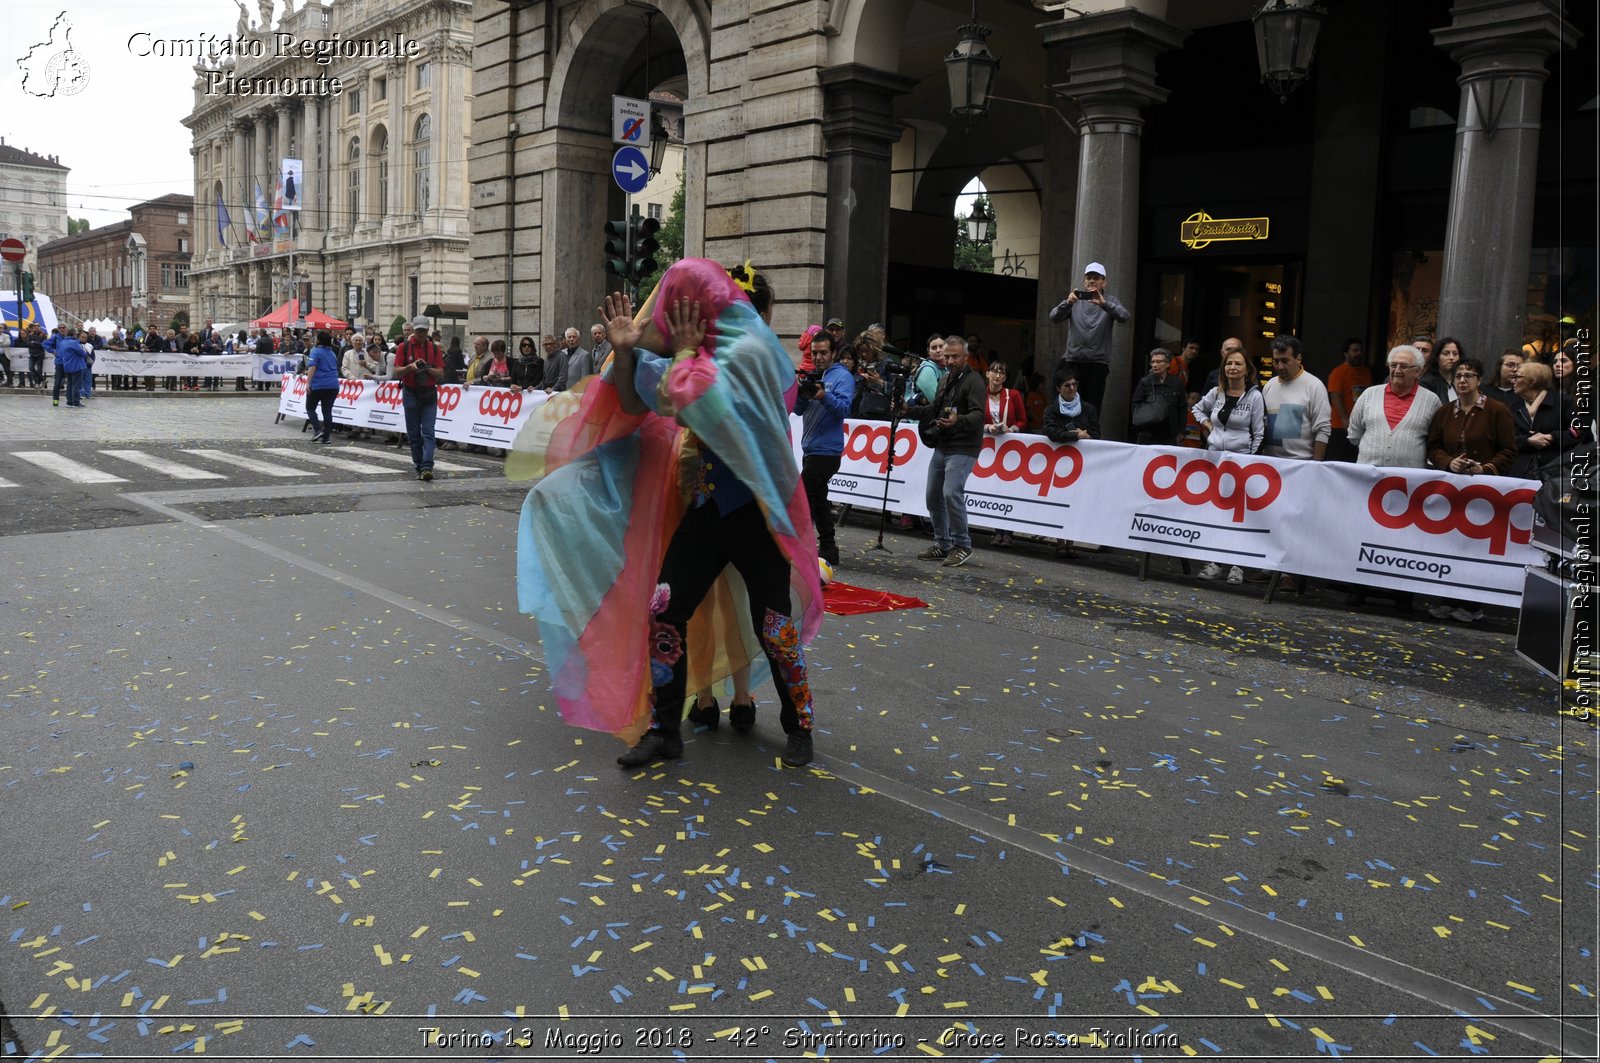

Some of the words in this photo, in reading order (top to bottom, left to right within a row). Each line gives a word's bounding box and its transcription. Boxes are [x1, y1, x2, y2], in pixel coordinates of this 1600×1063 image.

[620, 108, 645, 117] pedonale
[262, 360, 299, 375] Cuk
[479, 390, 523, 424] coop
[471, 425, 493, 437] Novacoop
[828, 477, 858, 491] vacoop
[1142, 454, 1282, 523] coop
[1131, 517, 1201, 543] Novacoop
[1358, 547, 1452, 578] Novacoop
